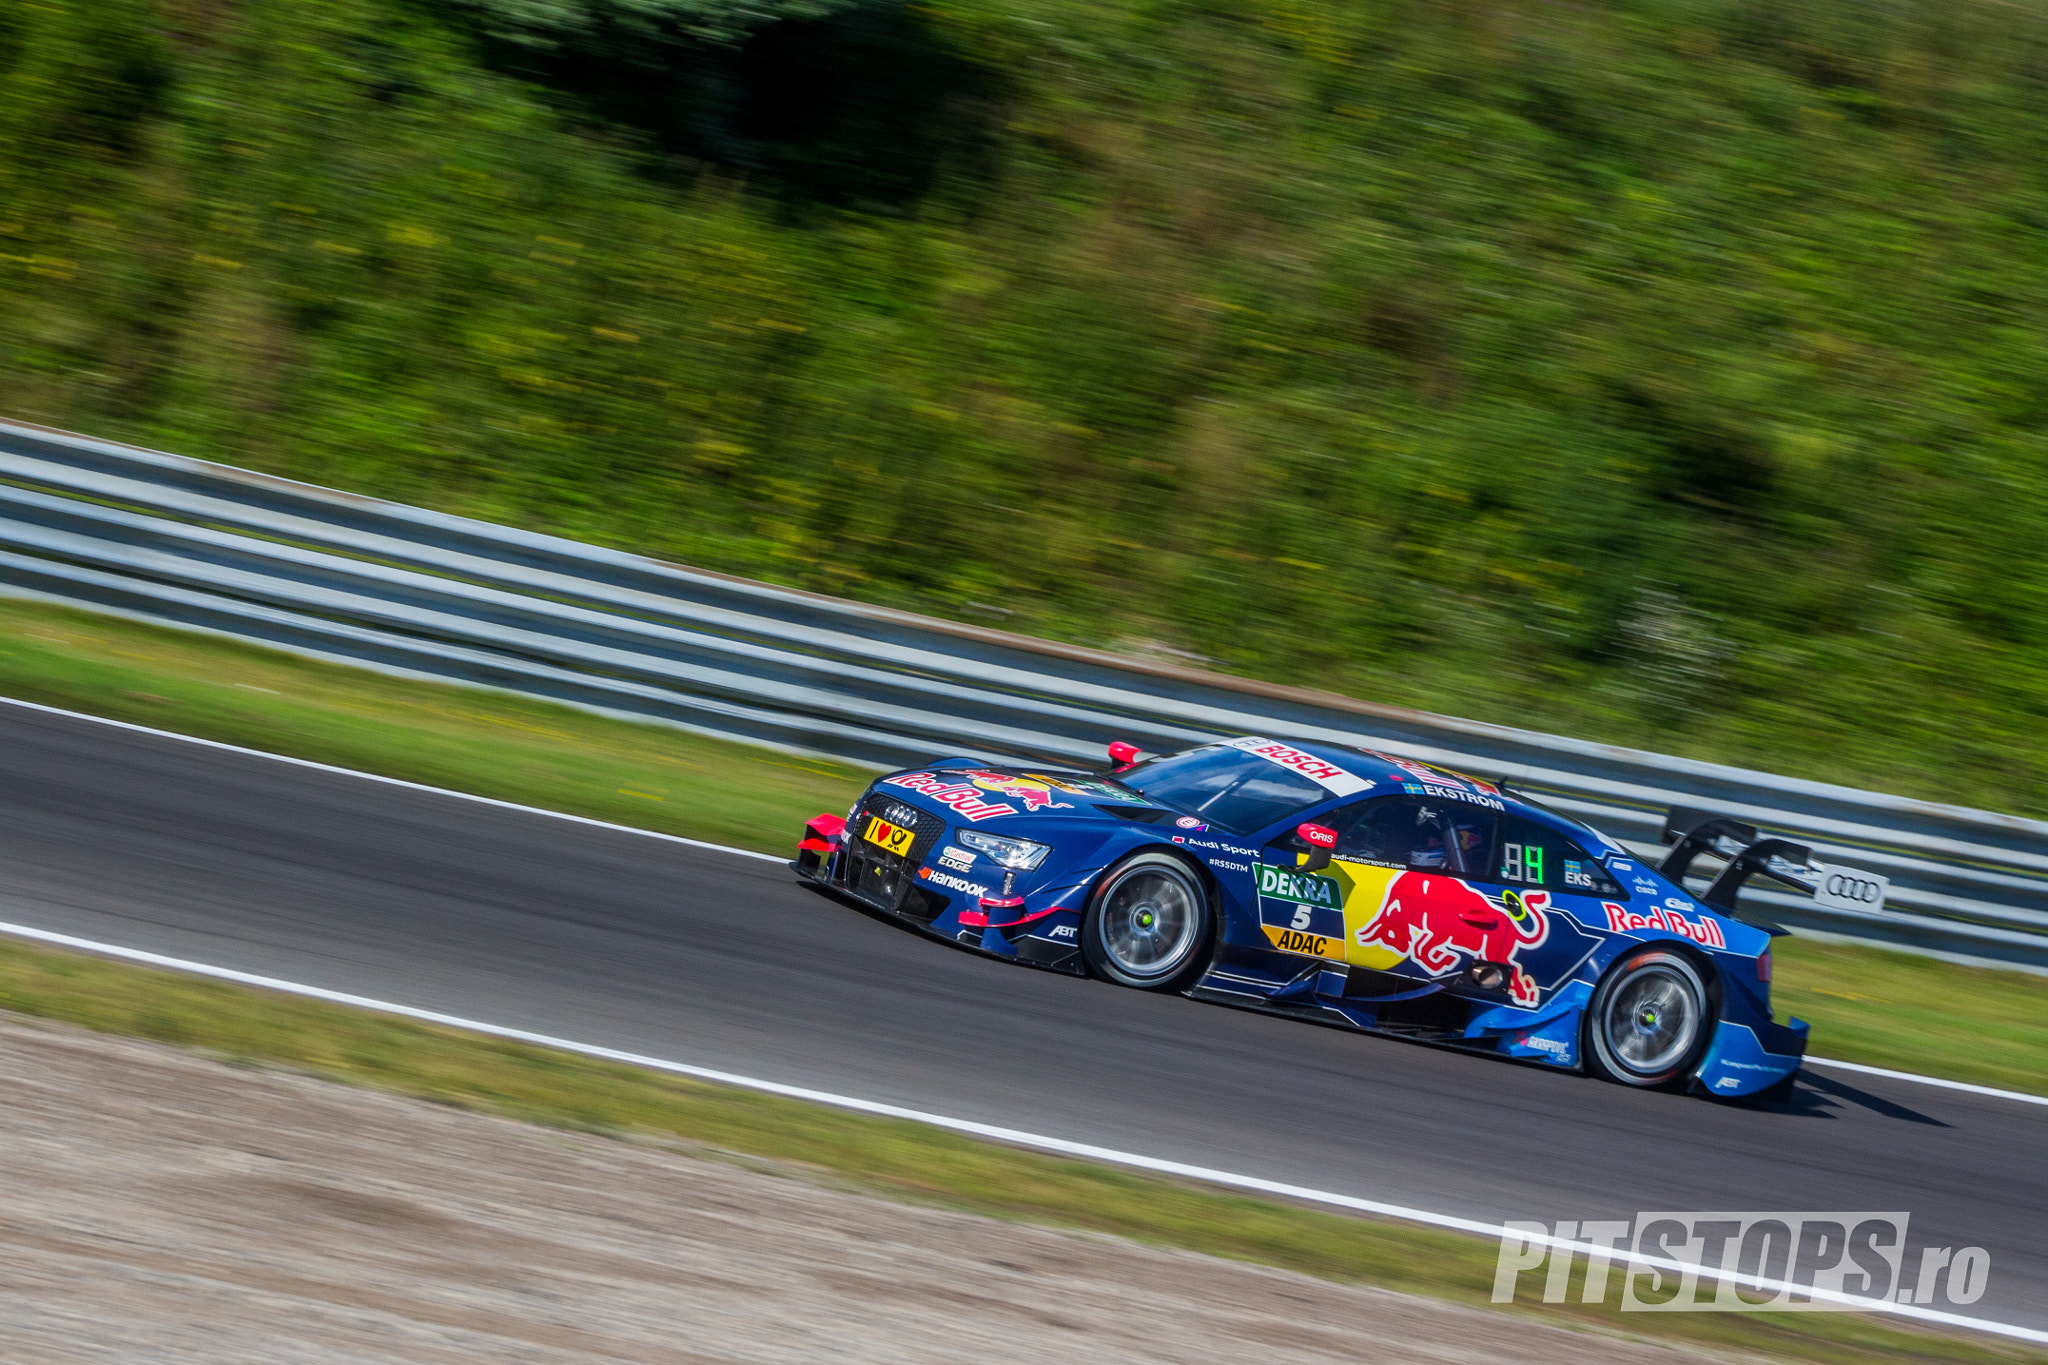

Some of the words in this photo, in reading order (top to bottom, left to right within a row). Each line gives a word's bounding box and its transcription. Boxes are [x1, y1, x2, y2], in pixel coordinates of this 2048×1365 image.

[1254, 745, 1343, 780] BOSCH
[1310, 831, 1334, 844] ORIS
[1188, 837, 1220, 850] Audi
[1220, 842, 1261, 859] Sport
[937, 855, 973, 874] EDGE
[1330, 852, 1408, 870] audi-motorsport.com
[1261, 869, 1332, 905] DEKRA
[1564, 870, 1592, 887] EKS
[1290, 904, 1313, 931] 5
[1048, 924, 1078, 938] ABT
[1277, 929, 1328, 956] ADAC
